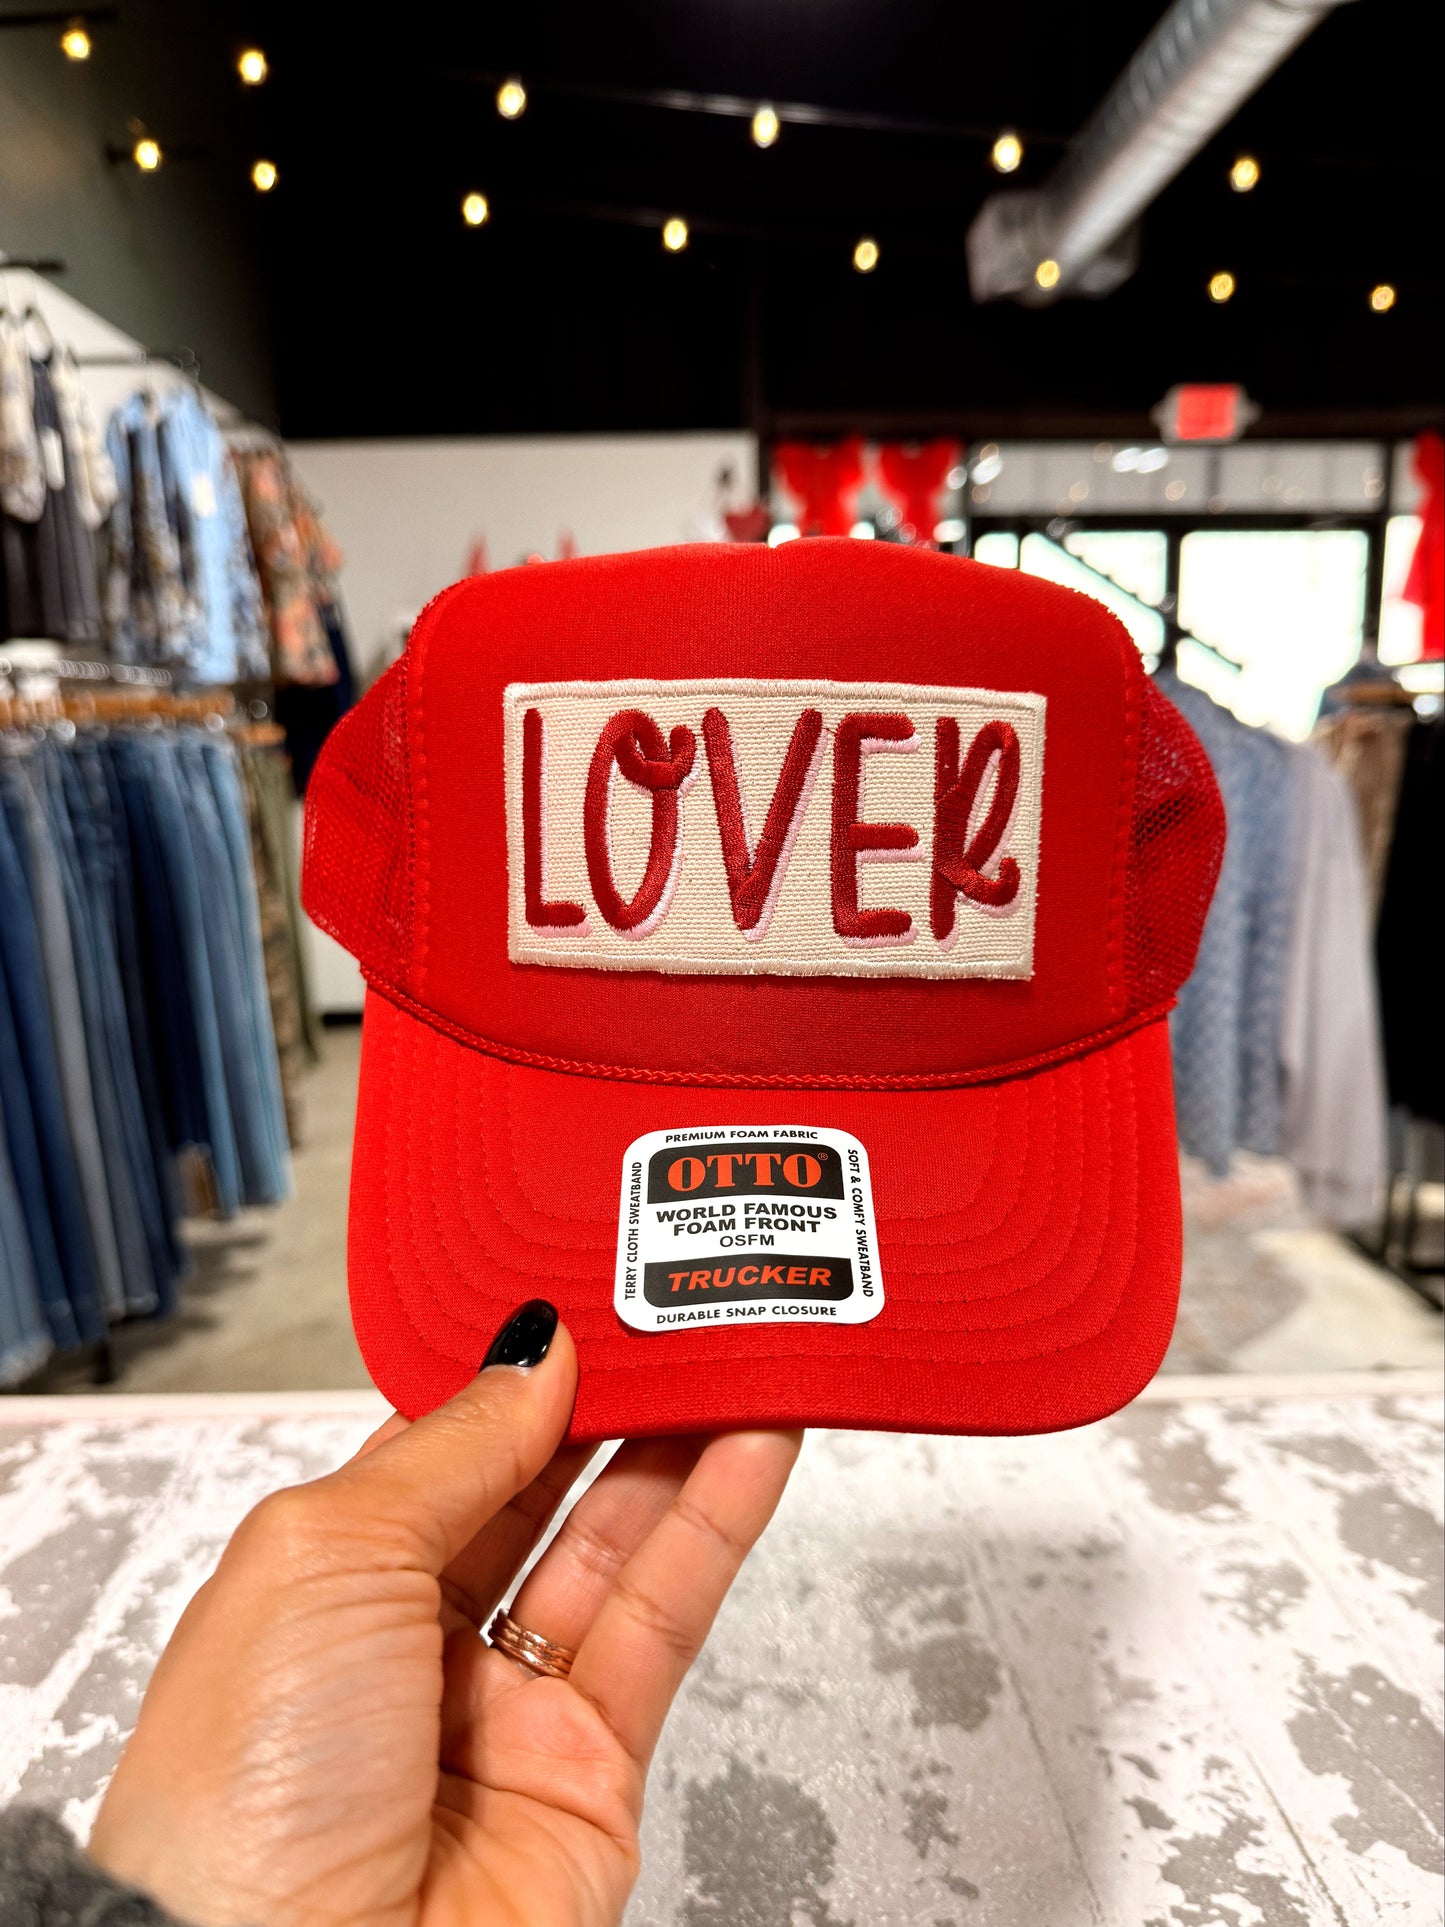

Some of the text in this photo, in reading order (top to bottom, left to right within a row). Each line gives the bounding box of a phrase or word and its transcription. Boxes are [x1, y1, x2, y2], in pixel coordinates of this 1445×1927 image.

[523, 706, 1021, 950] LOVER
[666, 1130, 818, 1142] PREMIUM FOAM FABRIC
[656, 1203, 837, 1222] WORLD FAMOUS
[625, 1162, 642, 1299] TERRY CLOTH SWEATBAND
[674, 1218, 820, 1235] FOAM FRONT
[848, 1149, 874, 1297] SOFT & COMFY SWEATBAND
[720, 1235, 775, 1247] OSFM
[668, 1267, 832, 1291] TRUCKER
[657, 1306, 836, 1324] DURABLE SNAP CLOSURE
